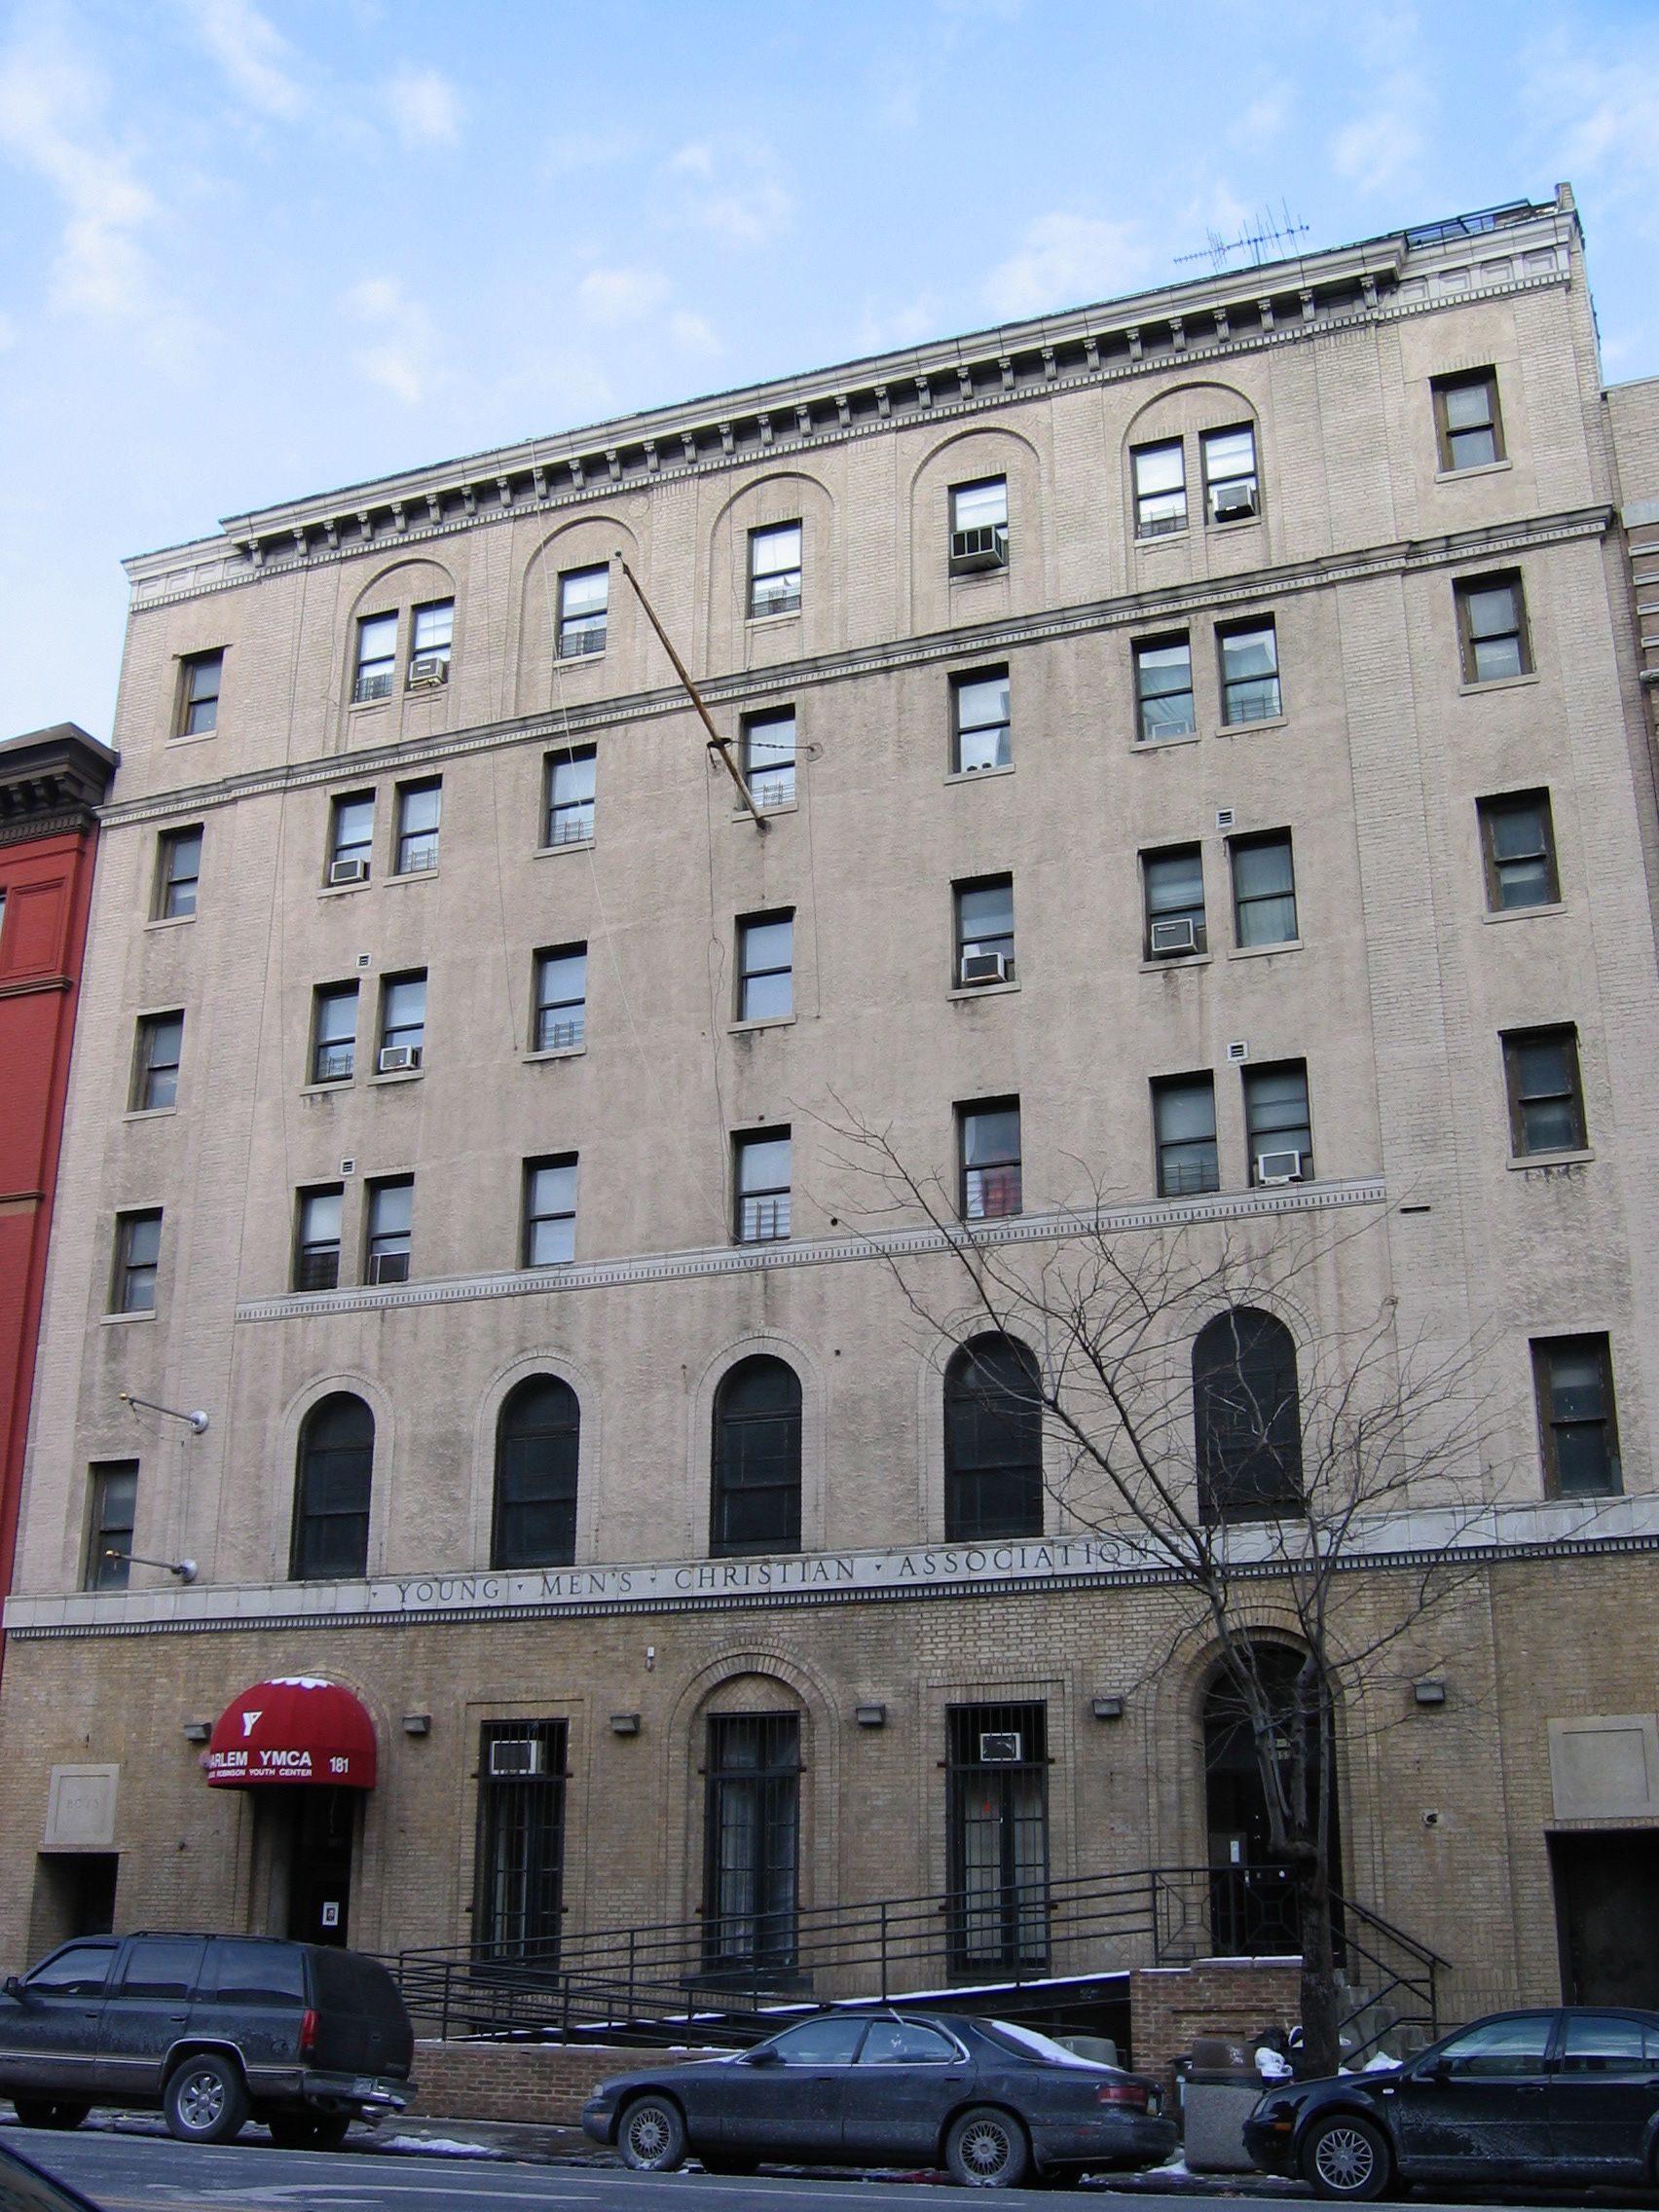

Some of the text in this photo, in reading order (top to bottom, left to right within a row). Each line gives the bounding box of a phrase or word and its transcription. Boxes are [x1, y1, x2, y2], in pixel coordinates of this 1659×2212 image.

[396, 1538, 1150, 1603] YOUNG MEN'S CHRISTIAN ASSOCIATION
[209, 1751, 312, 1768] ARLEM YMCA
[329, 1756, 349, 1773] 181
[249, 1768, 276, 1777] YOUTH
[278, 1768, 312, 1777] CENTER
